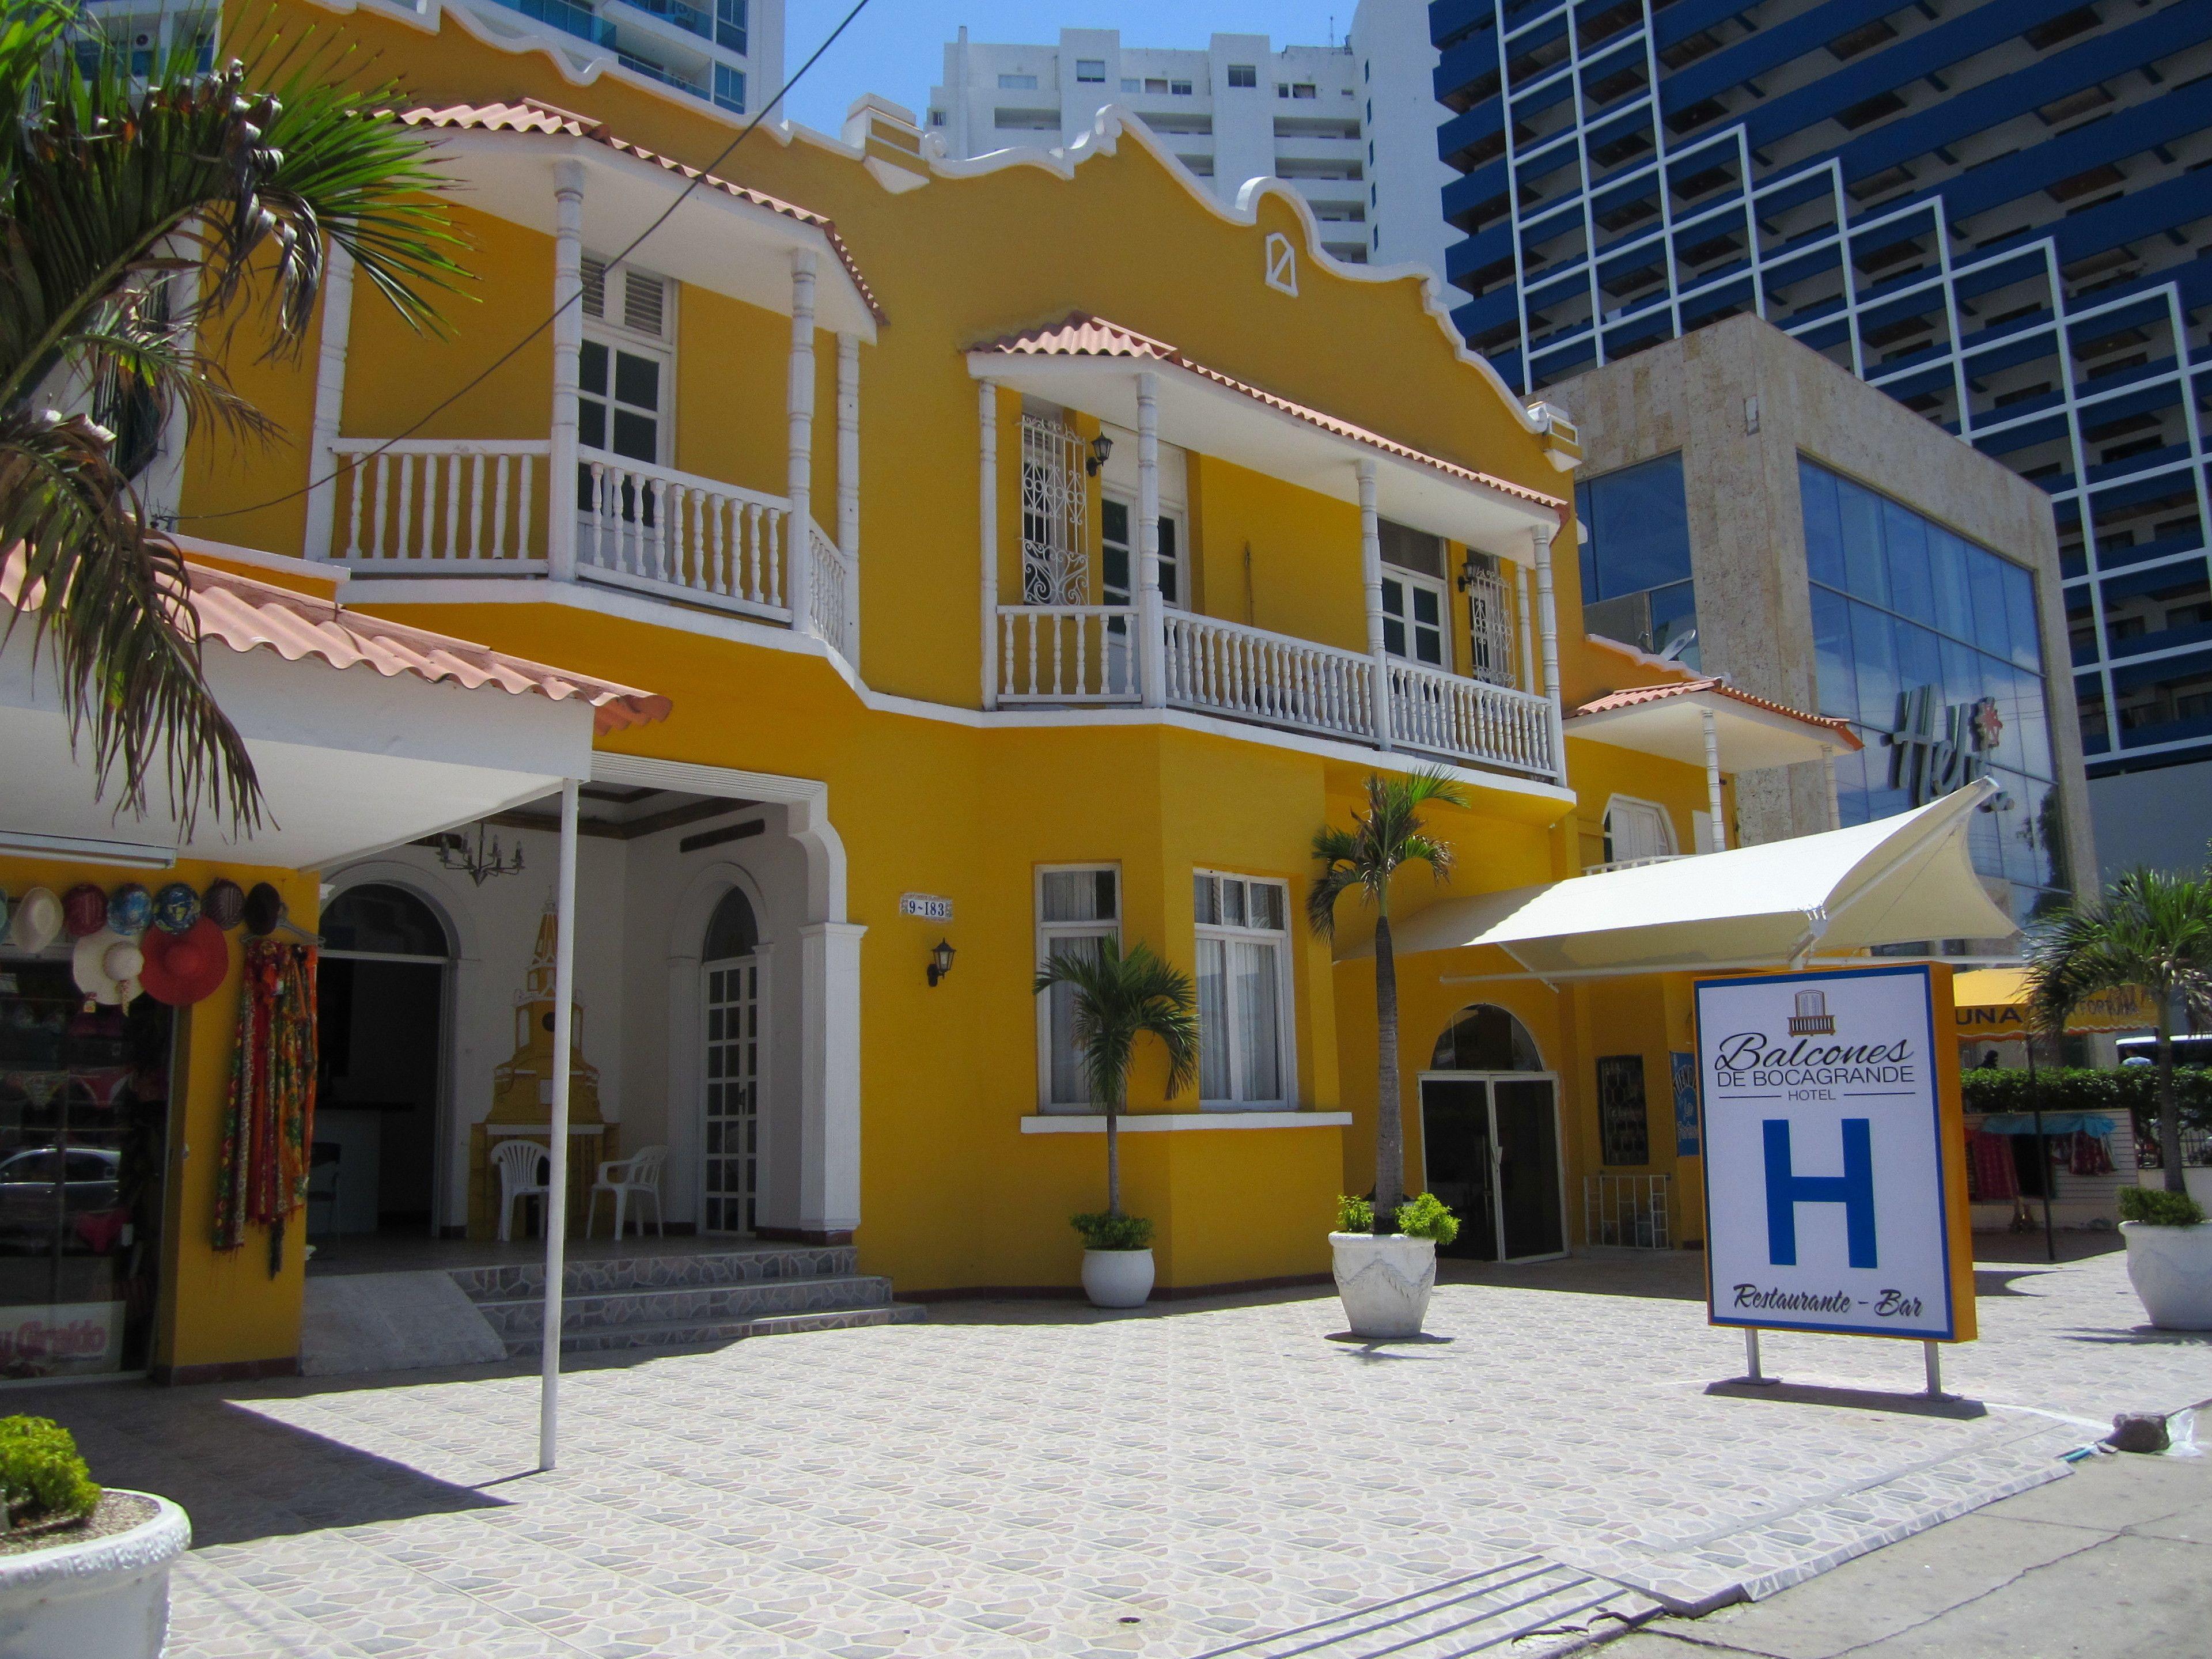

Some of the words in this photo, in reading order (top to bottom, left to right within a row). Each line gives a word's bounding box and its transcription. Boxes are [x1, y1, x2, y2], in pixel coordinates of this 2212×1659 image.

[1714, 1032, 1915, 1071] Balcones
[1717, 1071, 1747, 1087] DE
[1753, 1065, 1915, 1086] BOCAGRANDE
[1788, 1089, 1836, 1101] HOTEL
[1763, 1118, 1877, 1269] H
[1733, 1283, 1851, 1313] Restaurante
[1873, 1288, 1922, 1317] Bar
